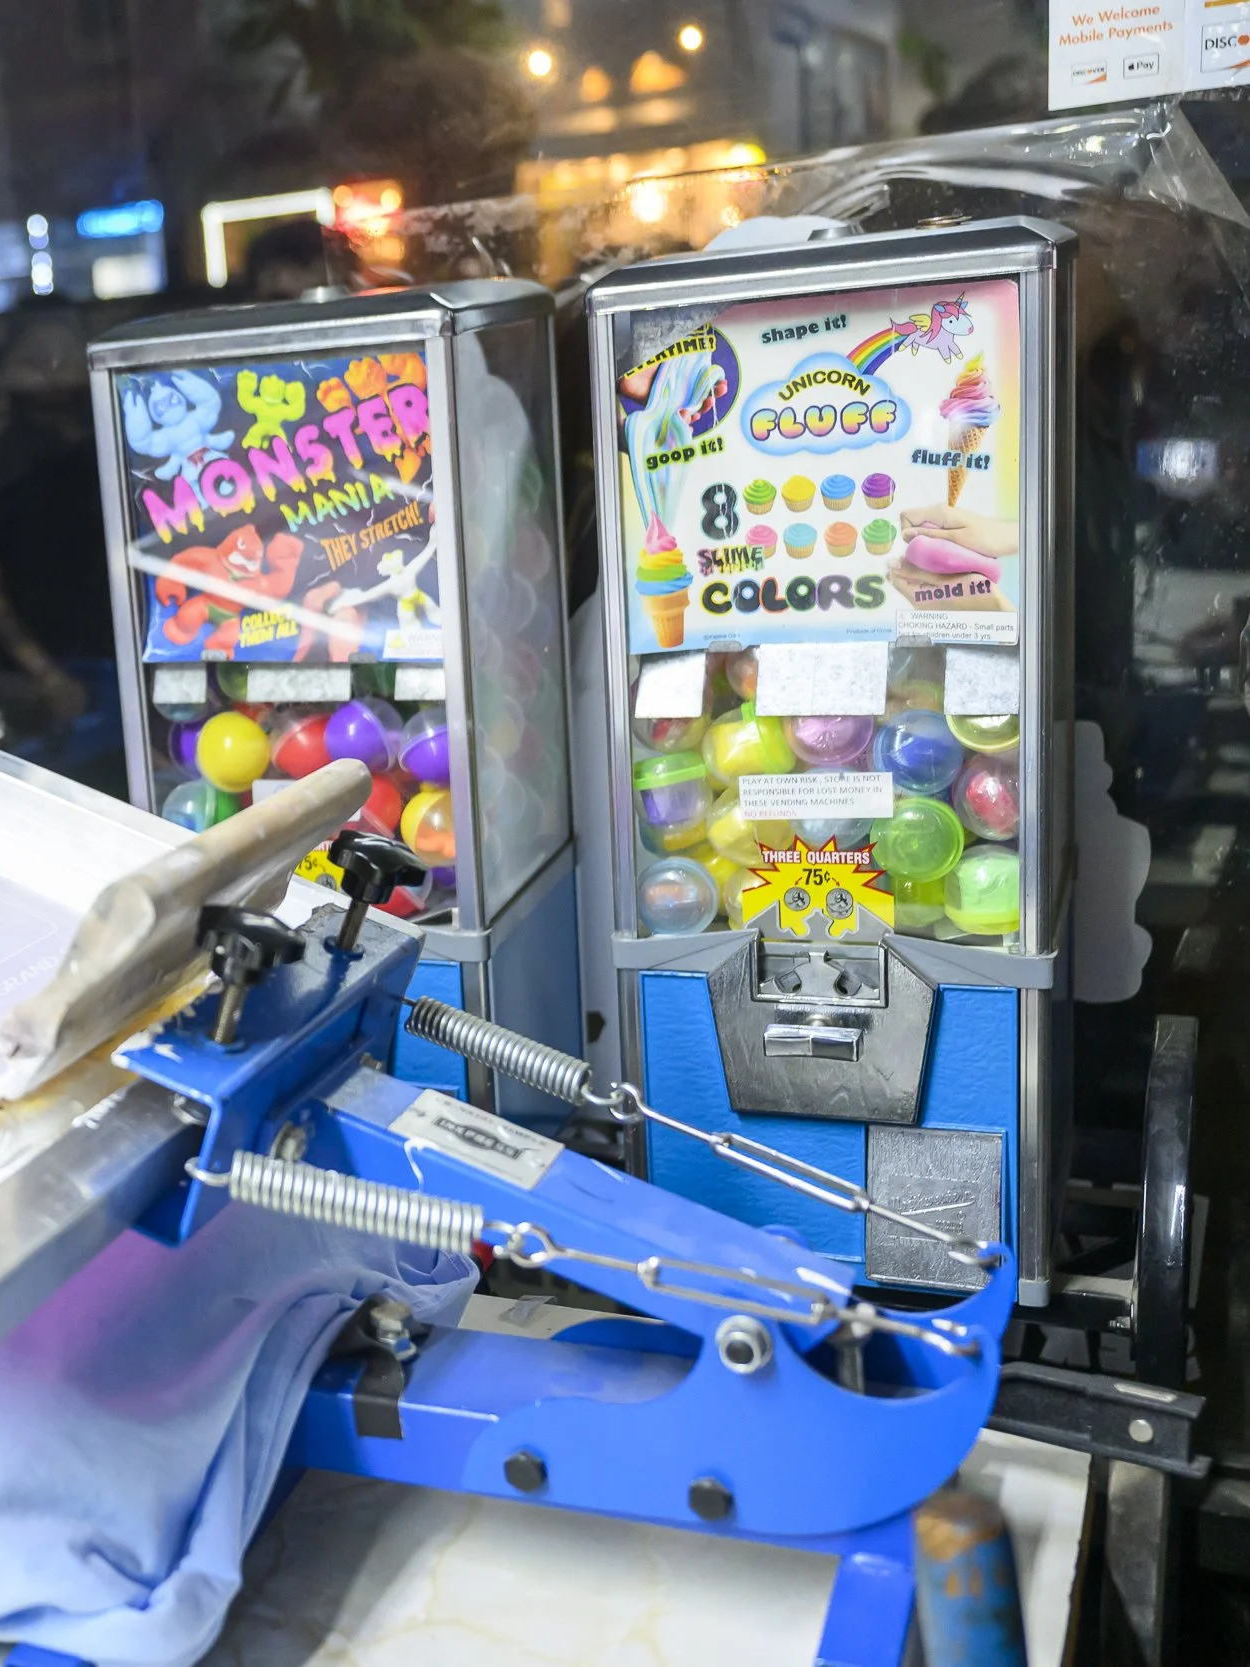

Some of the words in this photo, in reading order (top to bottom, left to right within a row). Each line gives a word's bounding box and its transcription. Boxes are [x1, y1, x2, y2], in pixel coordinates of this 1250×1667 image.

[1071, 14, 1094, 27] We
[1098, 5, 1160, 23] Welcome
[1059, 27, 1104, 46] Mobile
[1108, 19, 1173, 41] Payments
[761, 322, 820, 344] shape
[824, 314, 847, 331] it!
[778, 370, 871, 401] UNICORN
[750, 399, 897, 442] FLUFF
[142, 382, 430, 544] MONSTER
[646, 447, 695, 470] goop
[700, 437, 724, 455] it!
[911, 448, 962, 467] fluff
[965, 453, 991, 470] it!
[279, 473, 395, 533] MANIA
[701, 482, 740, 541] 8
[320, 533, 358, 572] THEY
[359, 500, 425, 550] STRETCH!
[698, 546, 765, 574] SLIME
[701, 575, 887, 615] COLORS
[914, 582, 964, 602] mold
[969, 579, 992, 595] it!
[897, 622, 934, 630] CHOKING
[935, 622, 968, 630] HAZARD
[974, 623, 994, 631] Small
[995, 624, 1014, 632] parts
[910, 612, 949, 621] WARNING
[951, 632, 972, 640] under
[980, 633, 991, 642] yrs
[742, 777, 762, 785] PLAY
[776, 776, 798, 784] OWN
[862, 774, 881, 782] NOT
[743, 787, 796, 796] RESPONSIBLE
[798, 787, 815, 795] FOR
[839, 786, 871, 794] MONEY
[744, 799, 768, 807] THESE
[770, 798, 808, 806] VENDING
[810, 798, 855, 806] MACHINES
[762, 850, 801, 864] THREE
[807, 851, 871, 866] QUARTERS
[802, 868, 831, 886] 75¢
